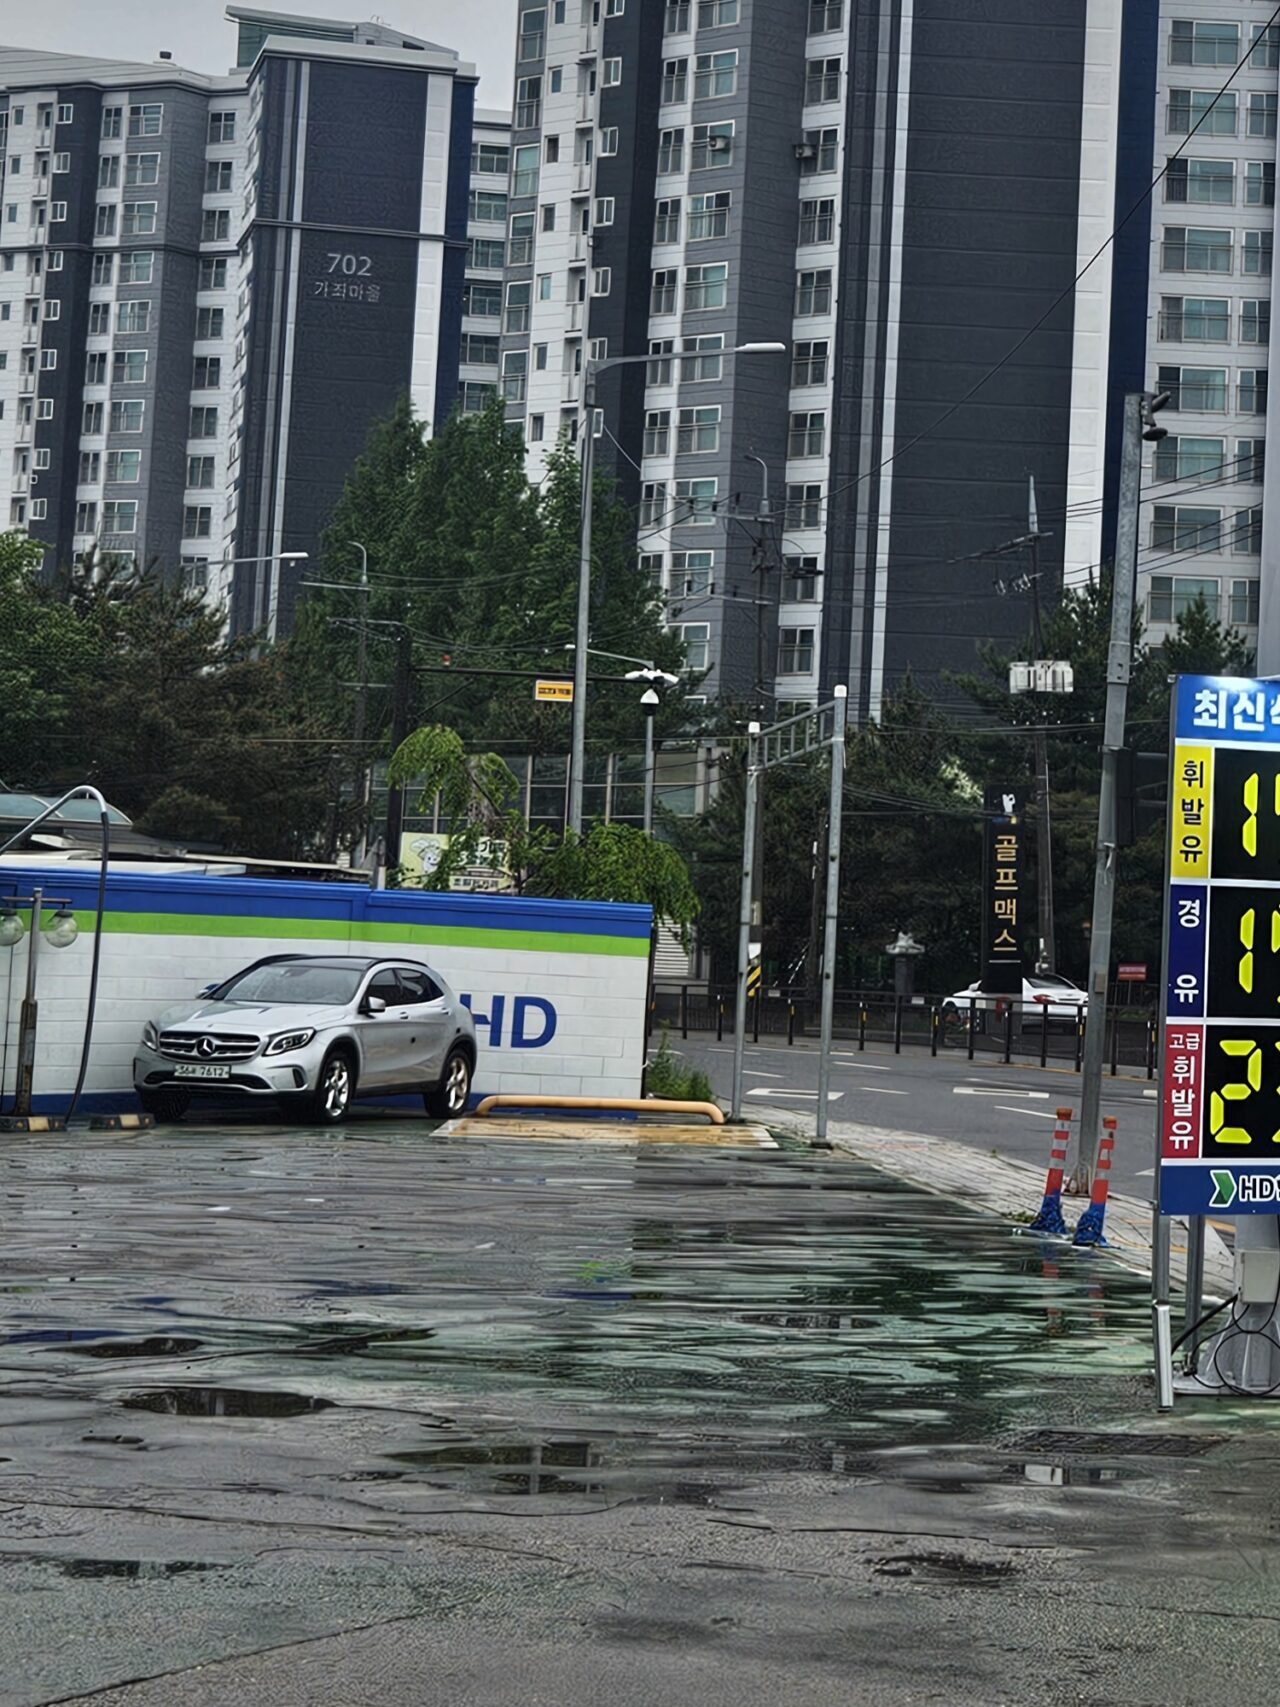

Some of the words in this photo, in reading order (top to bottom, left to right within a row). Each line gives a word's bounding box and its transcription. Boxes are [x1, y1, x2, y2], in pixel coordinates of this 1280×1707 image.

[327, 253, 372, 276] 702
[1179, 760, 1204, 863] 휘발유
[993, 835, 1018, 951] 골프맥스
[460, 994, 557, 1048] HD
[1169, 1033, 1200, 1049] 고급
[1169, 1056, 1195, 1150] 휘발유
